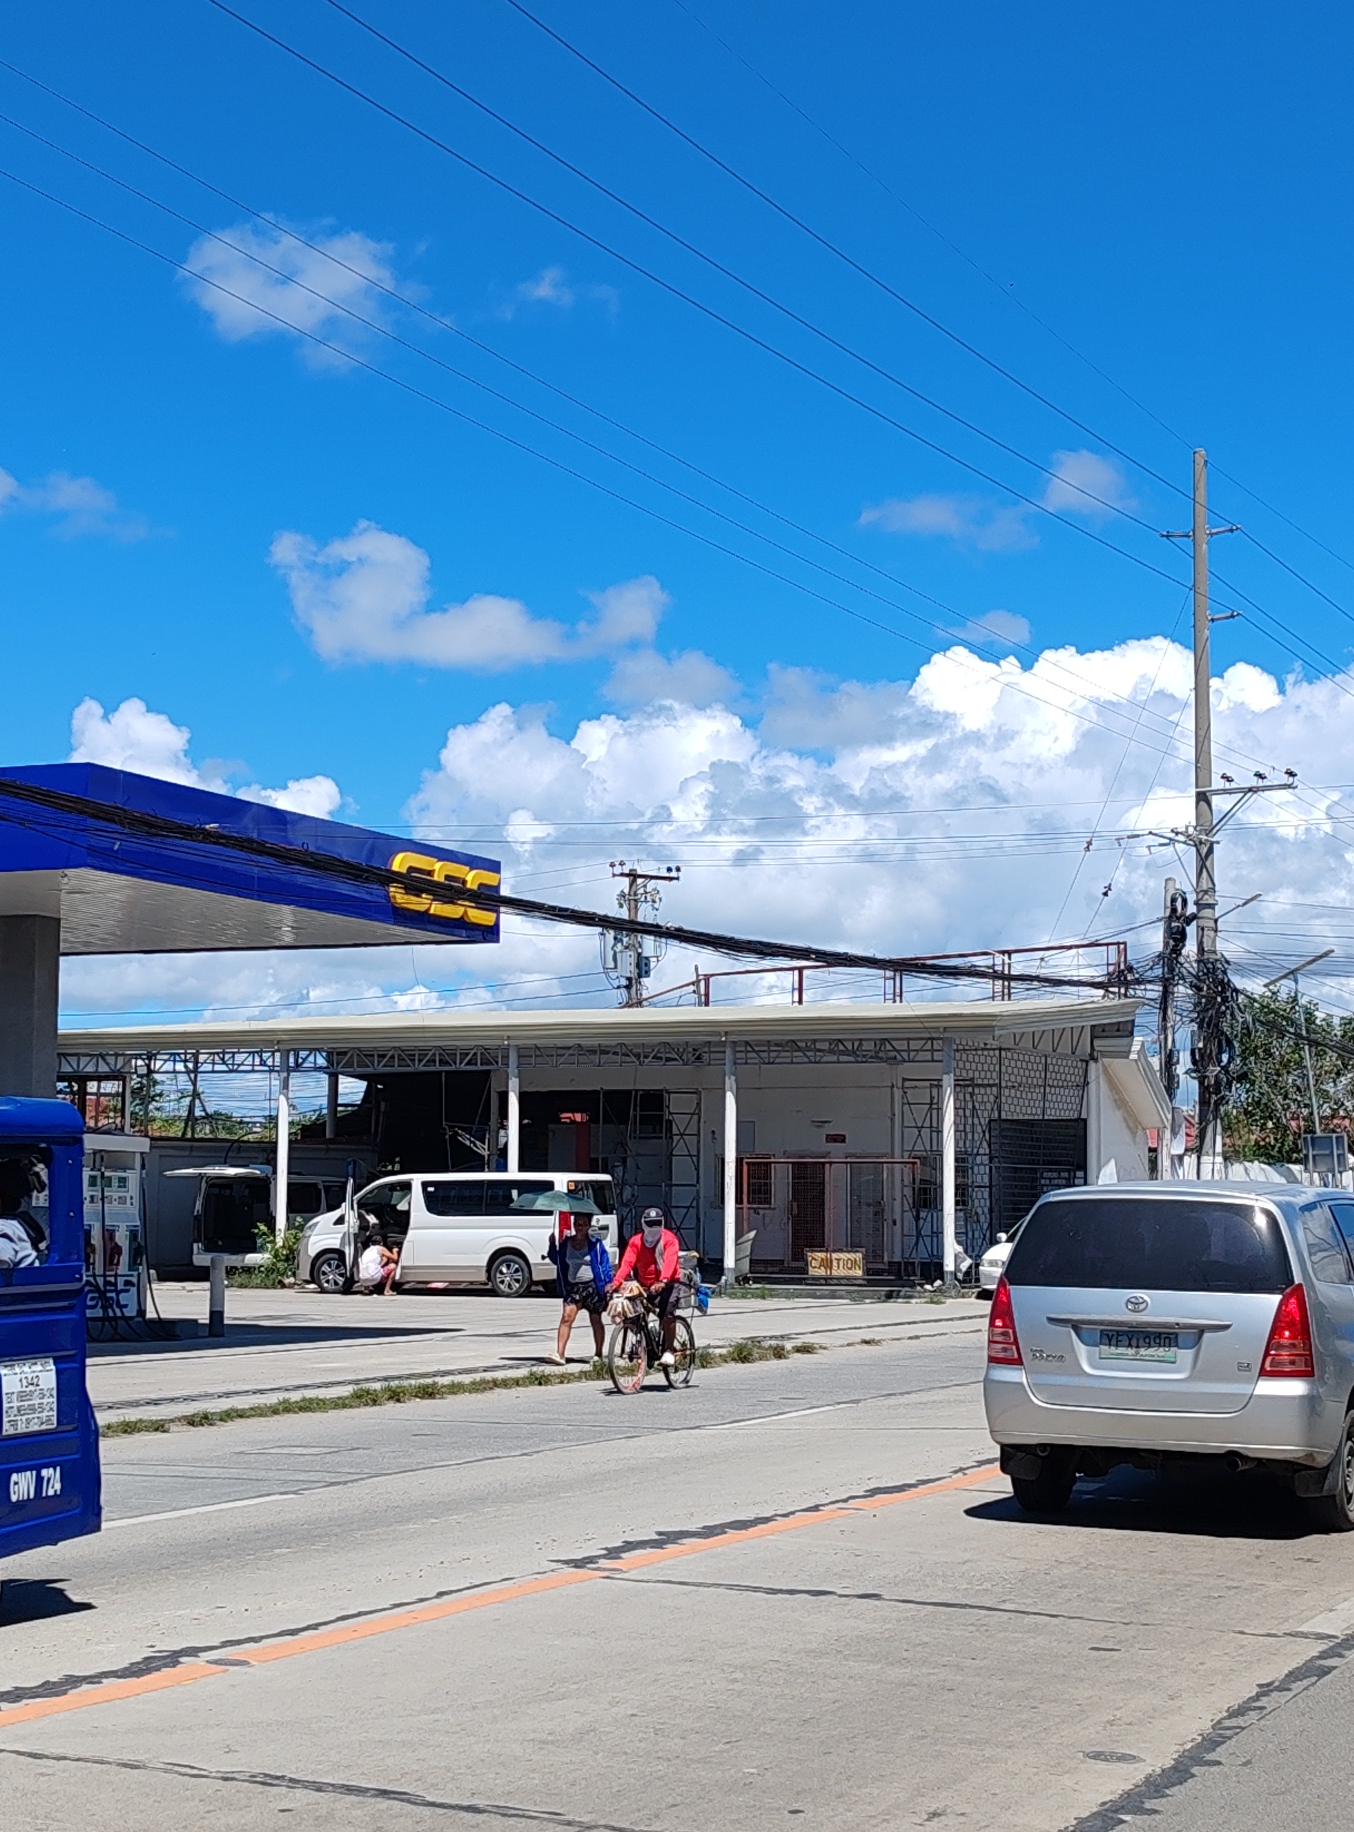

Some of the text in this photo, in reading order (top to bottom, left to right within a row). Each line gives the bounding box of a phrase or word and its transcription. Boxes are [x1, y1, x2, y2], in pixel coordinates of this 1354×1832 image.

[809, 1256, 861, 1270] CAUTION
[9, 1466, 62, 1503] GWV 724
